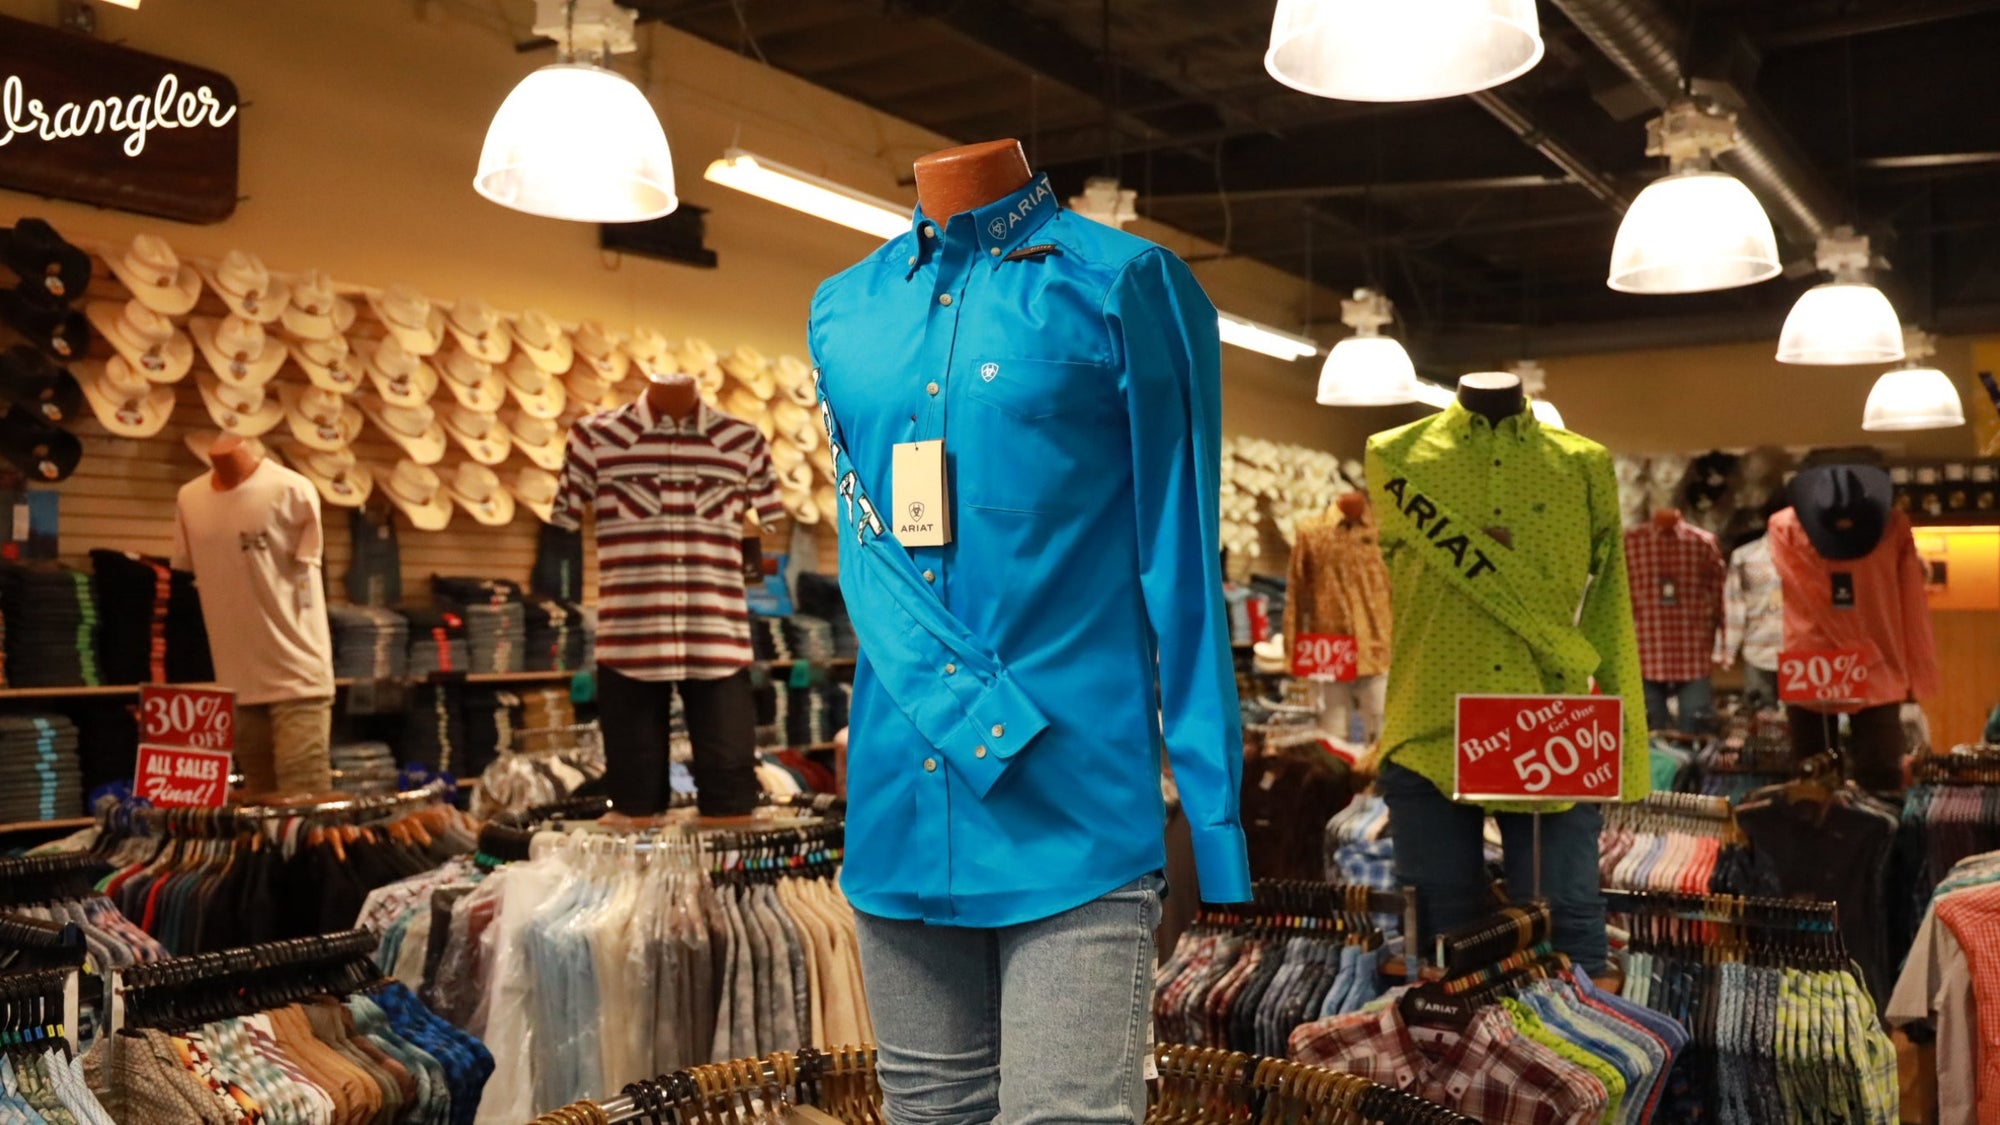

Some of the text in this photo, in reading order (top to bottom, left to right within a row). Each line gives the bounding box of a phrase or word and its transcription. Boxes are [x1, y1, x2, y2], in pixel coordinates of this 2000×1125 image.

[1008, 176, 1052, 229] ARIAT
[901, 524, 934, 533] ARIAT
[1383, 478, 1497, 579] ARIAT
[1296, 638, 1358, 667] 20%
[1781, 653, 1868, 692] 20%
[1815, 684, 1854, 700] OFF
[144, 693, 231, 735] 30%
[1548, 704, 1596, 734] Get One
[188, 731, 227, 749] OFF
[1460, 699, 1566, 763] Buy One
[145, 753, 220, 780] ALL SALES
[1513, 718, 1617, 792] 50%
[145, 776, 218, 805] Final!
[1582, 763, 1614, 789] Off
[1424, 1002, 1459, 1015] ARIAT
